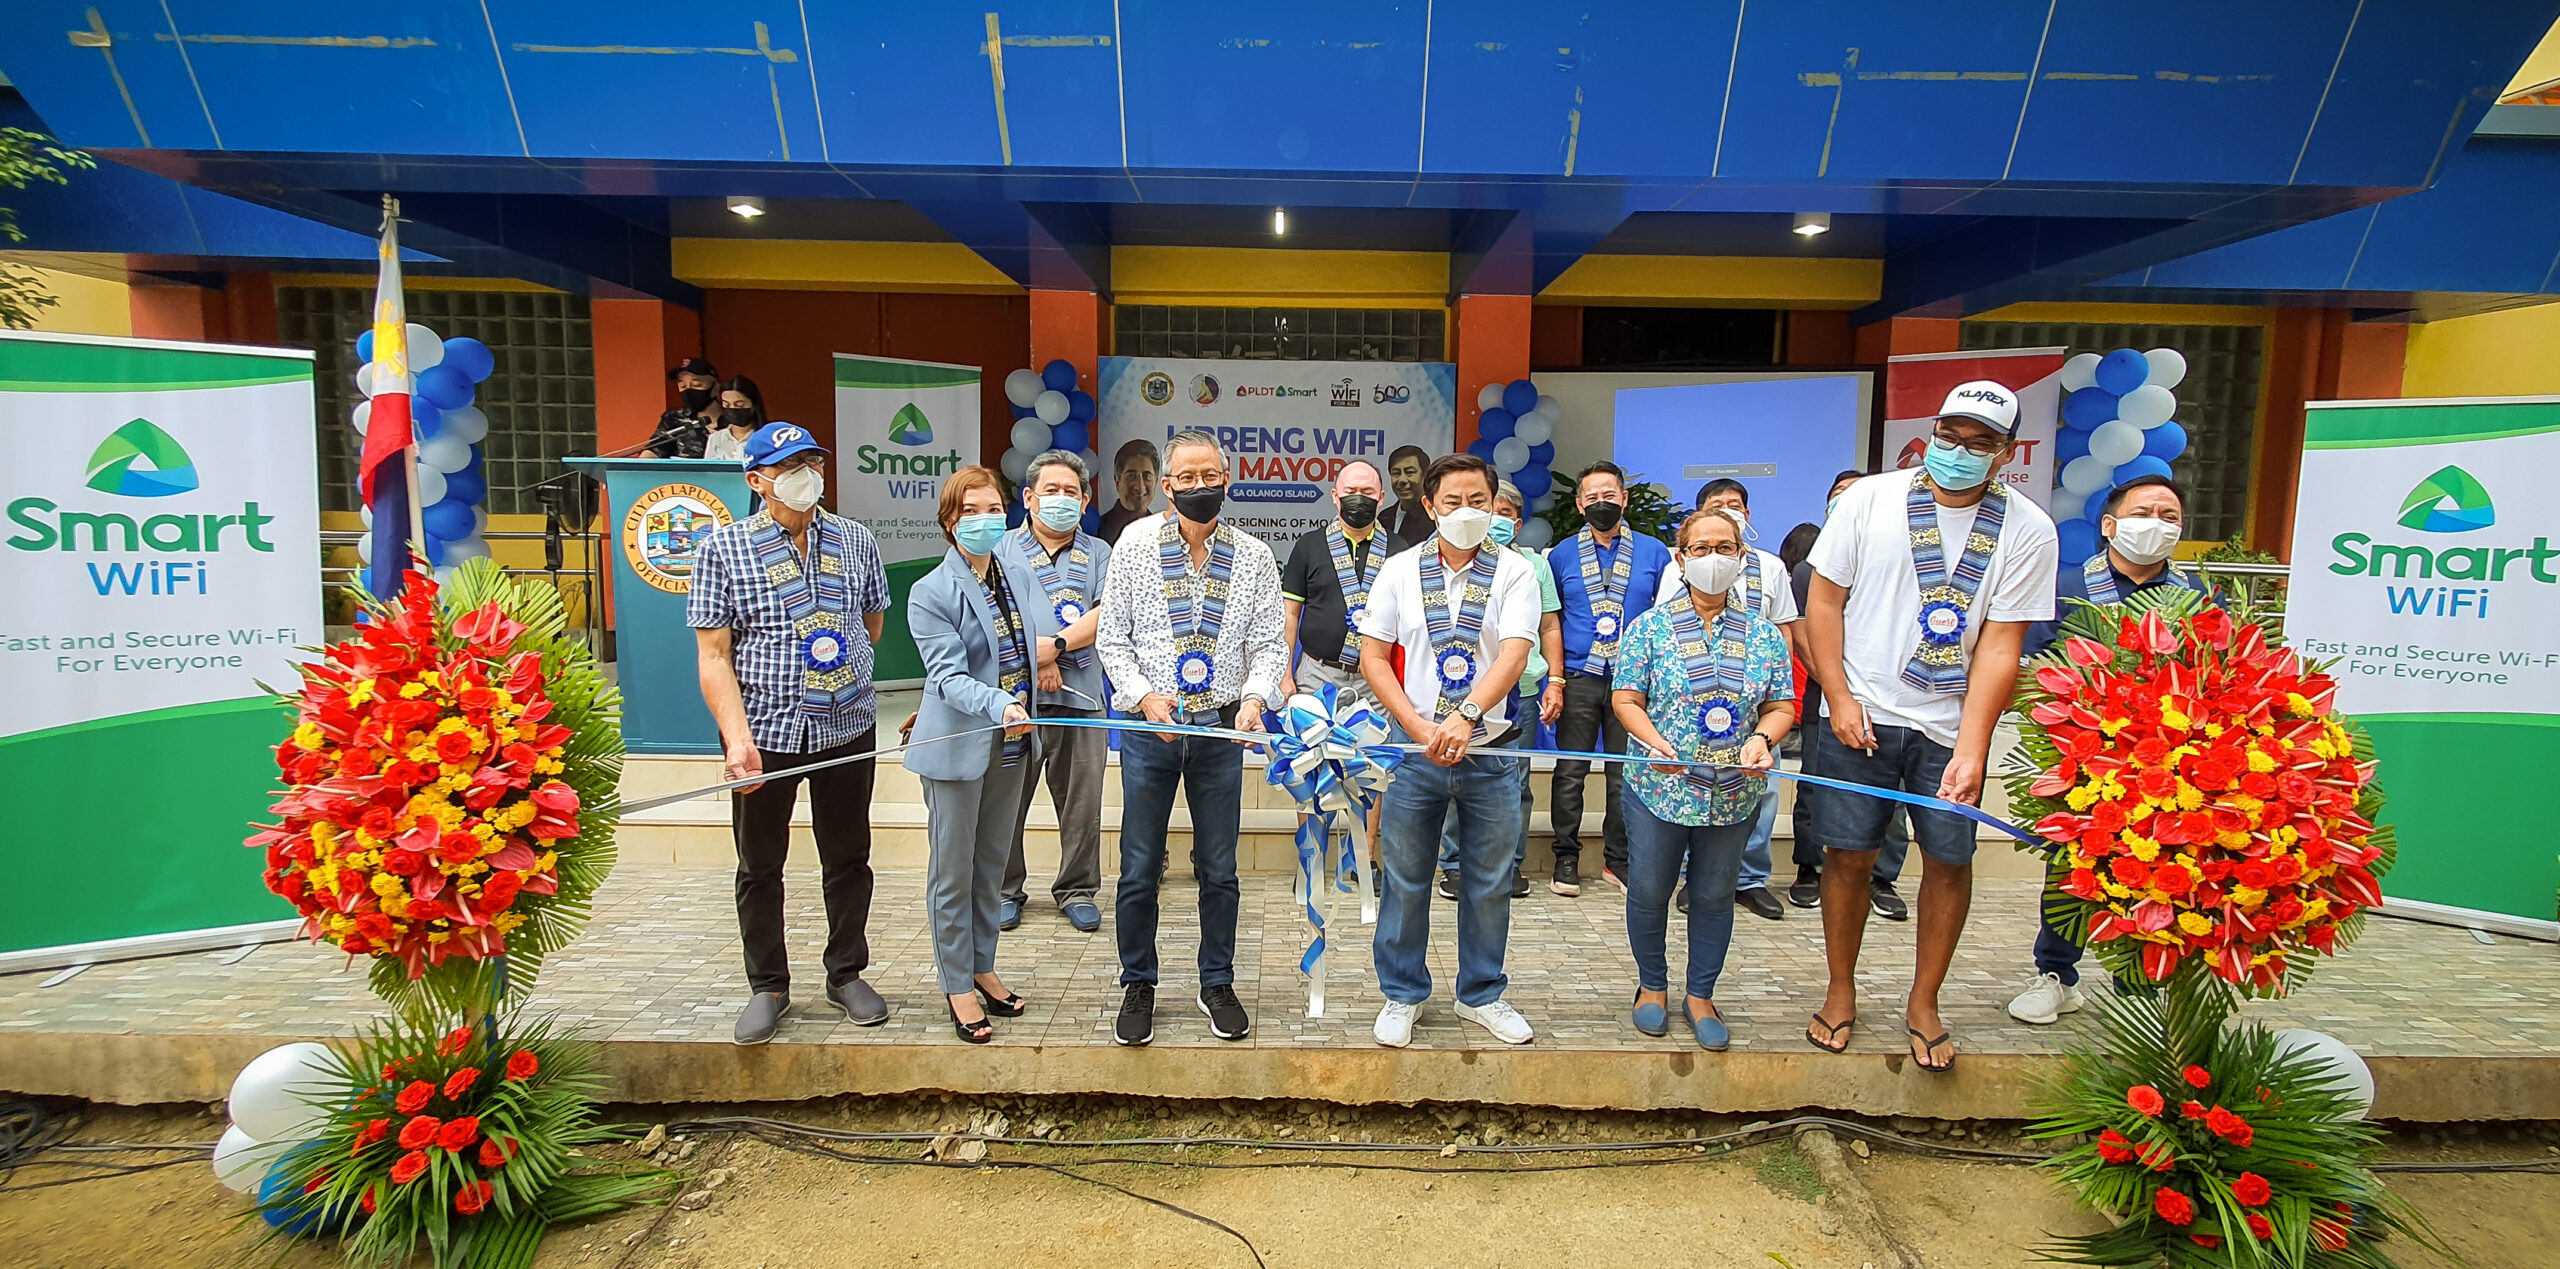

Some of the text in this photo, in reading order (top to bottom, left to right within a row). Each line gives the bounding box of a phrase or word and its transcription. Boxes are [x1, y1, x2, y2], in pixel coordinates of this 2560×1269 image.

[1248, 387, 1275, 396] PLDT
[1287, 387, 1317, 396] Smart
[1313, 428, 1385, 455] WIFI
[857, 444, 963, 477] Smart
[888, 480, 936, 499] WiFi
[1233, 488, 1317, 498] SA OLANGO ISLAND
[627, 501, 647, 531] CITY
[647, 487, 668, 503] OF
[5, 497, 276, 553] Smart
[876, 518, 898, 527] and
[1238, 518, 1287, 528] SIGNING
[1290, 518, 1307, 528] OF
[875, 530, 893, 539] For
[1273, 532, 1289, 541] SA
[2328, 532, 2560, 584] Smart
[86, 560, 208, 596] WiFi
[635, 561, 691, 591] OFFICIA
[2386, 586, 2490, 619] WiFi
[60, 633, 115, 650] and
[125, 631, 221, 648] Secure
[228, 628, 297, 646] Wi-Fi
[57, 655, 244, 673] For Everyone
[2305, 639, 2560, 668] Fast and Secure Wi-F
[2350, 660, 2509, 684] For Everyone
